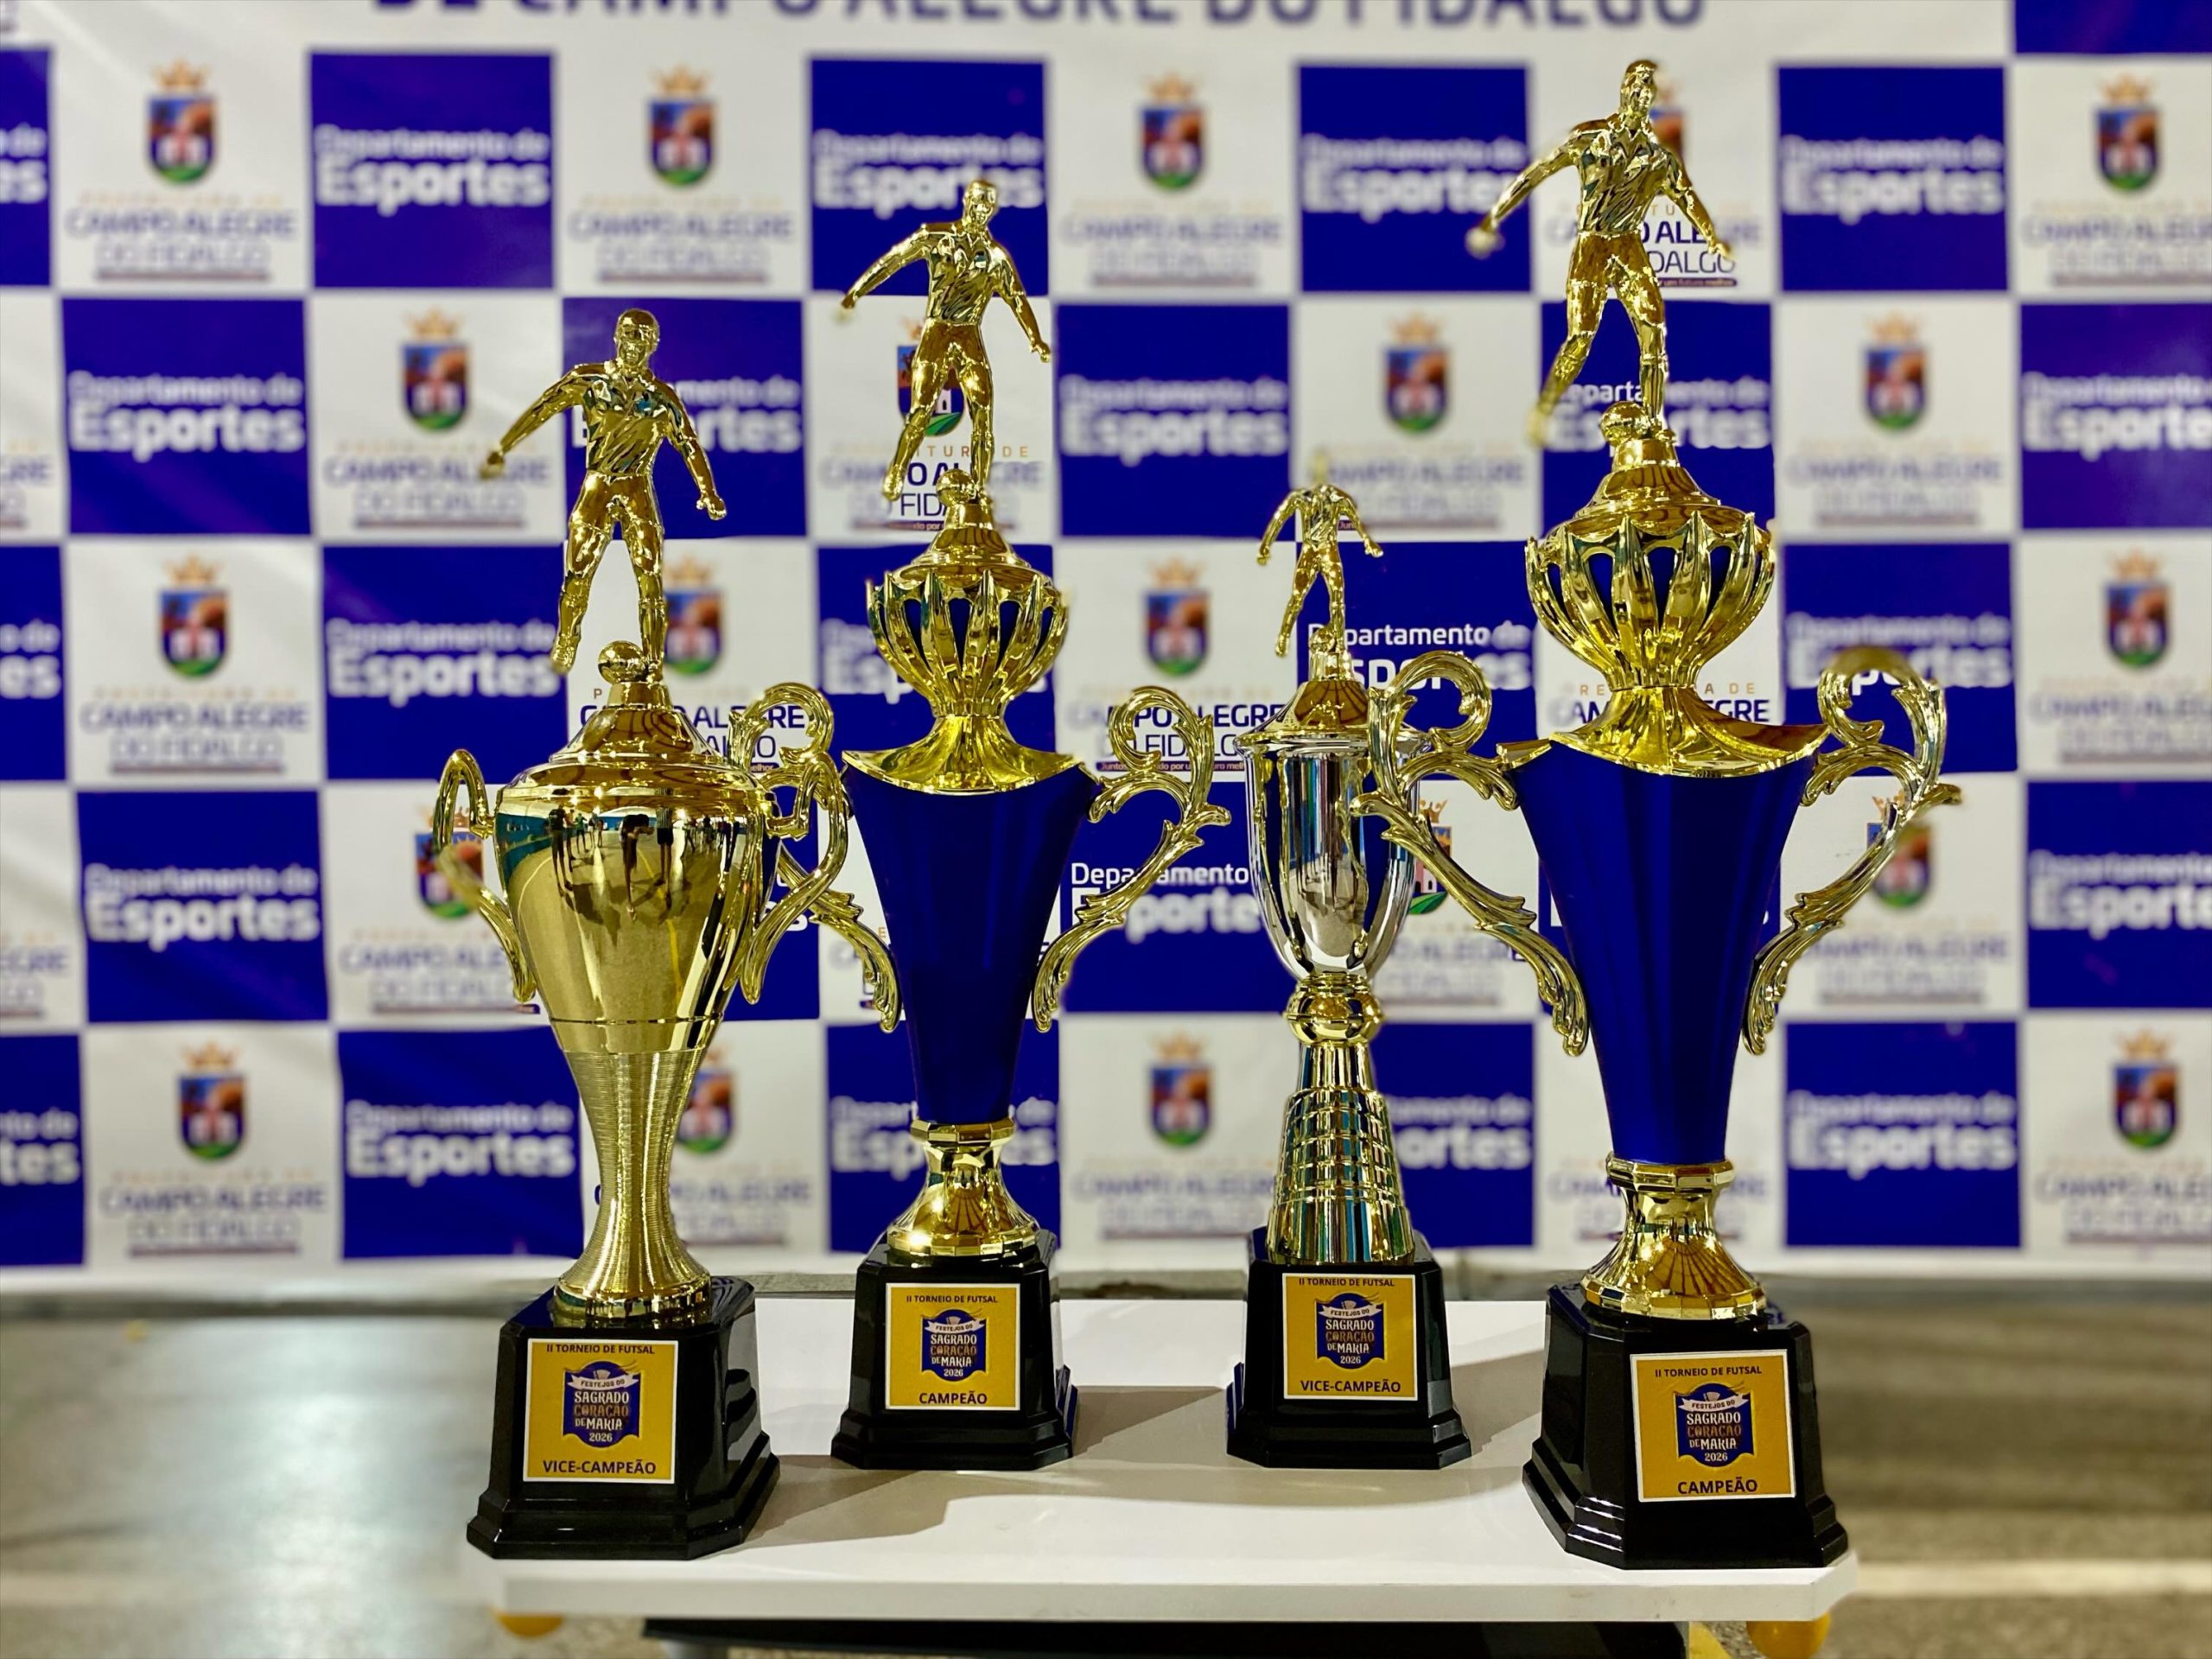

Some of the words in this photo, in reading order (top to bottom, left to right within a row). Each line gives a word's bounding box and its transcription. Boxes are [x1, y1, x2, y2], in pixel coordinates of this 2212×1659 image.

[316, 156, 549, 216] Esportes
[1303, 165, 1517, 223] Esporte
[68, 404, 303, 461] Esportes
[2023, 402, 2212, 461] Esporte
[326, 649, 557, 707] Esportes
[86, 894, 319, 951] Esportes
[1395, 1125, 1531, 1170] ortes
[348, 1129, 575, 1185] Esportes
[1325, 1319, 1374, 1331] SAGRADO
[930, 1334, 977, 1346] SAGRADO
[1327, 1343, 1338, 1351] DE
[546, 1344, 553, 1353] II
[556, 1344, 600, 1353] TORNEIO
[603, 1344, 615, 1353] DE
[619, 1344, 655, 1355] FUTSAL
[931, 1357, 941, 1365] DE
[944, 1369, 964, 1377] 2026
[1656, 1369, 1661, 1377] II
[1664, 1368, 1708, 1377] TORNEIO
[1711, 1367, 1723, 1376] DE
[1726, 1365, 1762, 1376] FUTSAL
[581, 1379, 615, 1388] FESTEJOS
[1300, 1379, 1402, 1393] VICE-CAMPEÃO
[574, 1391, 629, 1405] SAGRADO
[919, 1391, 988, 1405] CAMPEÃO
[1692, 1402, 1725, 1410] FESTEJOS
[575, 1417, 586, 1427] DE
[1687, 1412, 1741, 1426] SAGRADO
[589, 1433, 613, 1443] 2026
[1689, 1438, 1700, 1448] DE
[1704, 1452, 1728, 1462] 2026
[543, 1459, 657, 1474] VICE-CAMPEÃO
[1678, 1477, 1758, 1495] CAMPEÃO
